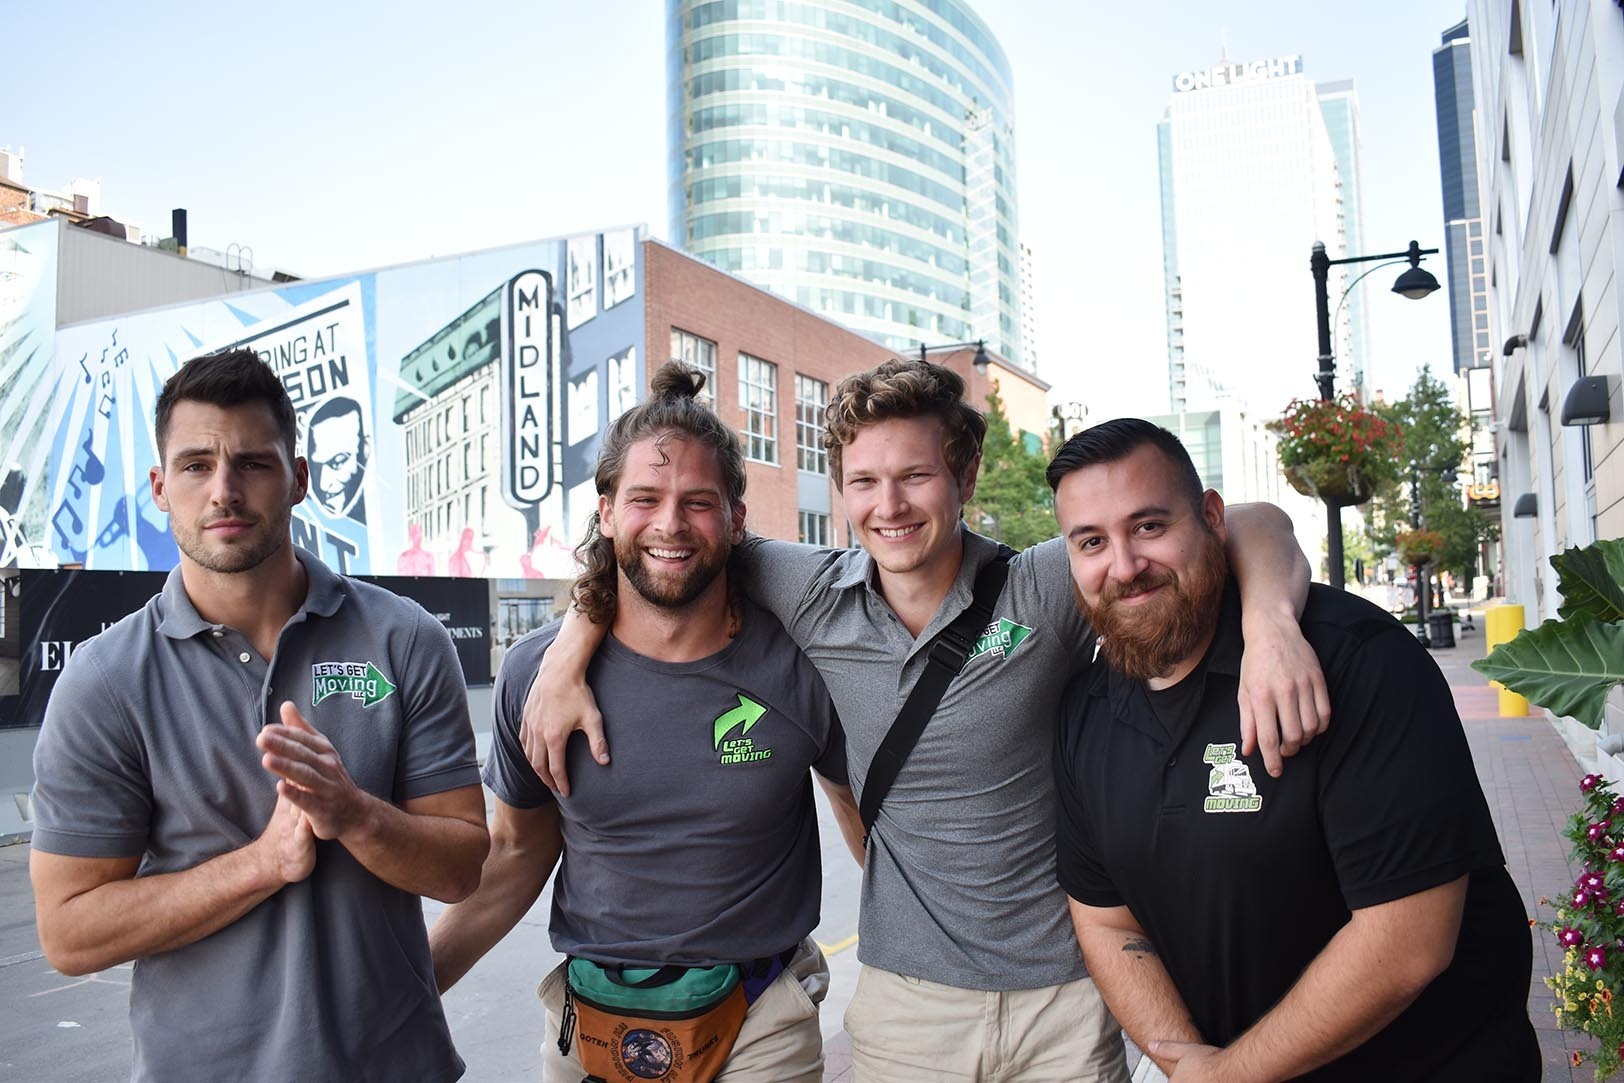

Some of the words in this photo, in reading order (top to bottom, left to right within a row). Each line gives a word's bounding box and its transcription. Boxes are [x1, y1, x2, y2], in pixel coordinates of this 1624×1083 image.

[1174, 67, 1228, 93] ONE
[1230, 54, 1303, 84] LIGHT
[313, 322, 339, 359] AT
[517, 284, 540, 490] MIDLAND
[314, 664, 344, 677] LET'S
[346, 665, 367, 677] GET
[315, 677, 377, 701] Moving
